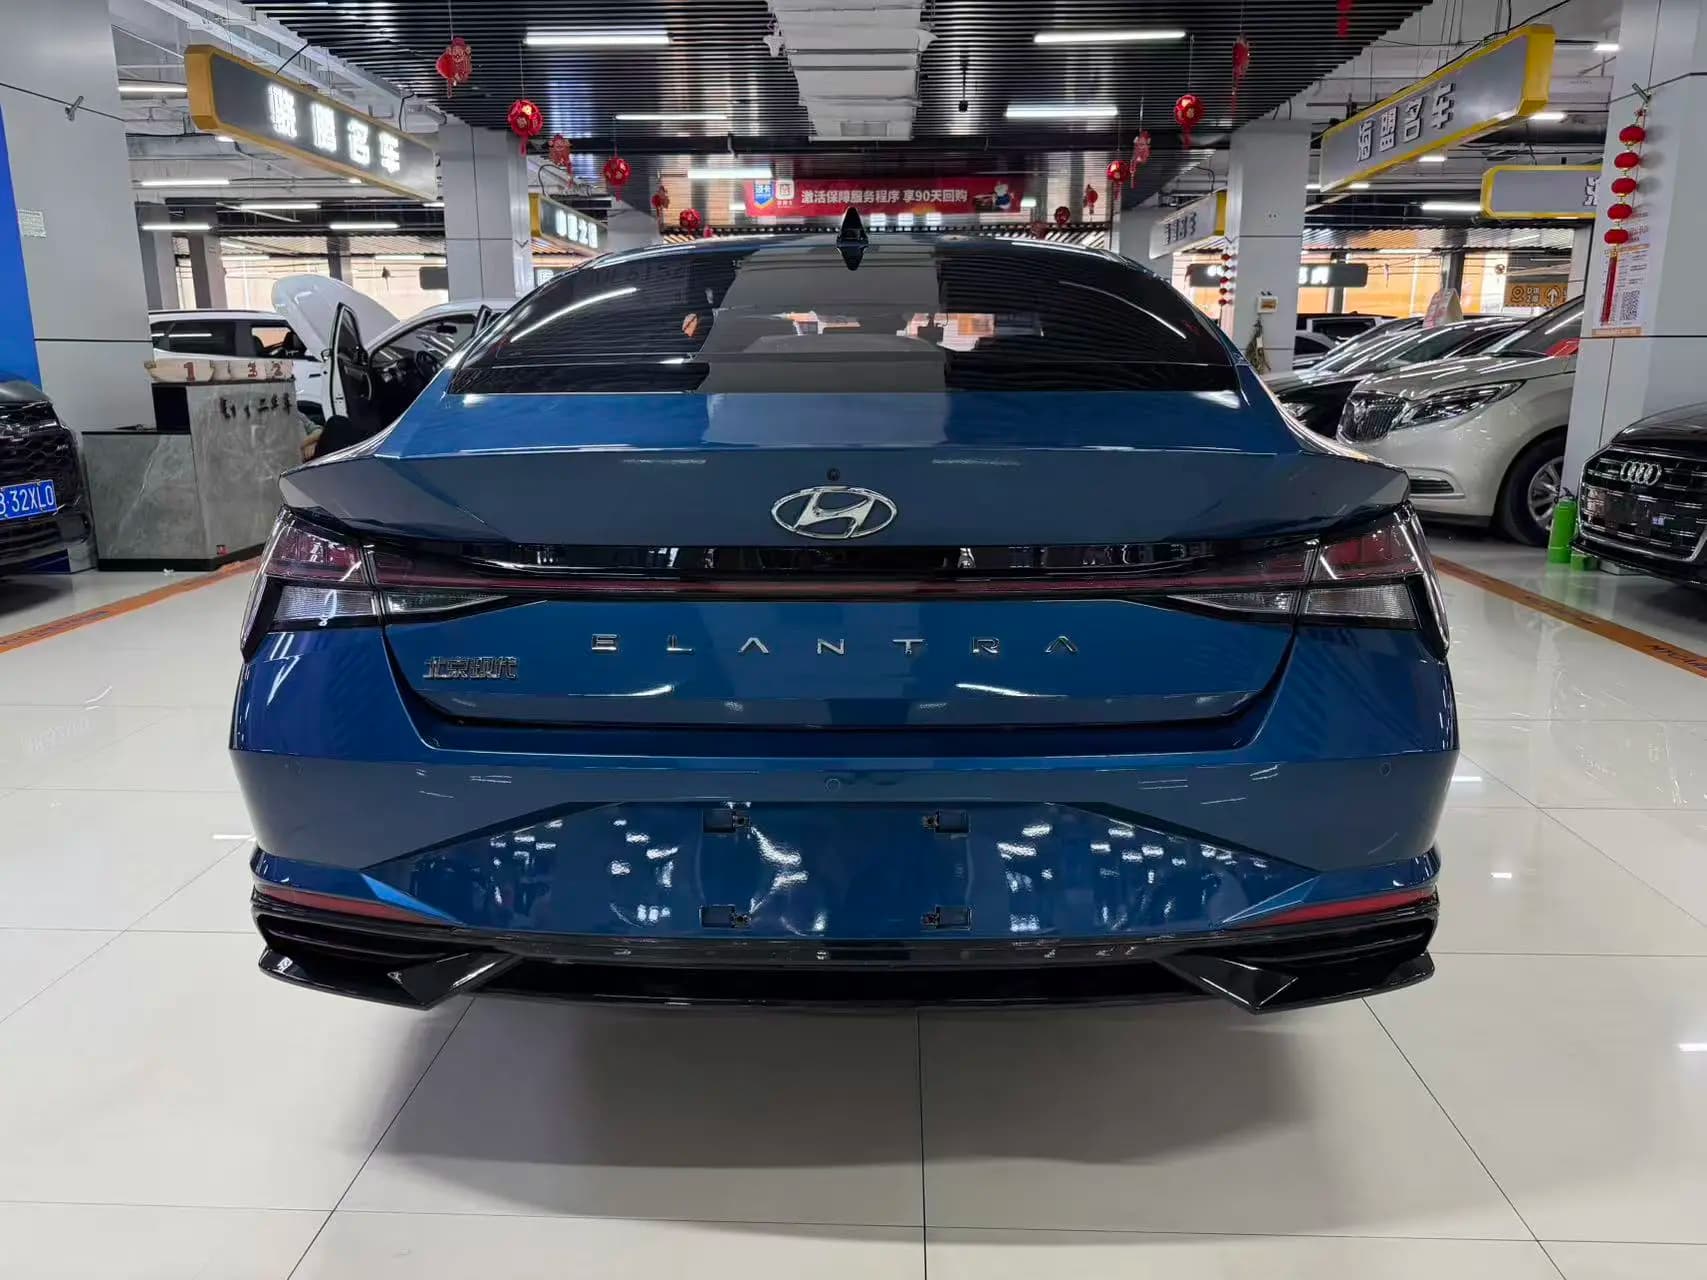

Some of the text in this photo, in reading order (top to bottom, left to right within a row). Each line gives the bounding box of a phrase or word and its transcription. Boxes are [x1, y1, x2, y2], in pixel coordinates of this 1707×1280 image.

[801, 189, 900, 204] 激活保障服务程序
[902, 188, 968, 203] 享90天回购
[591, 633, 1078, 655] ELANTRA
[422, 656, 517, 679] 北京现代
